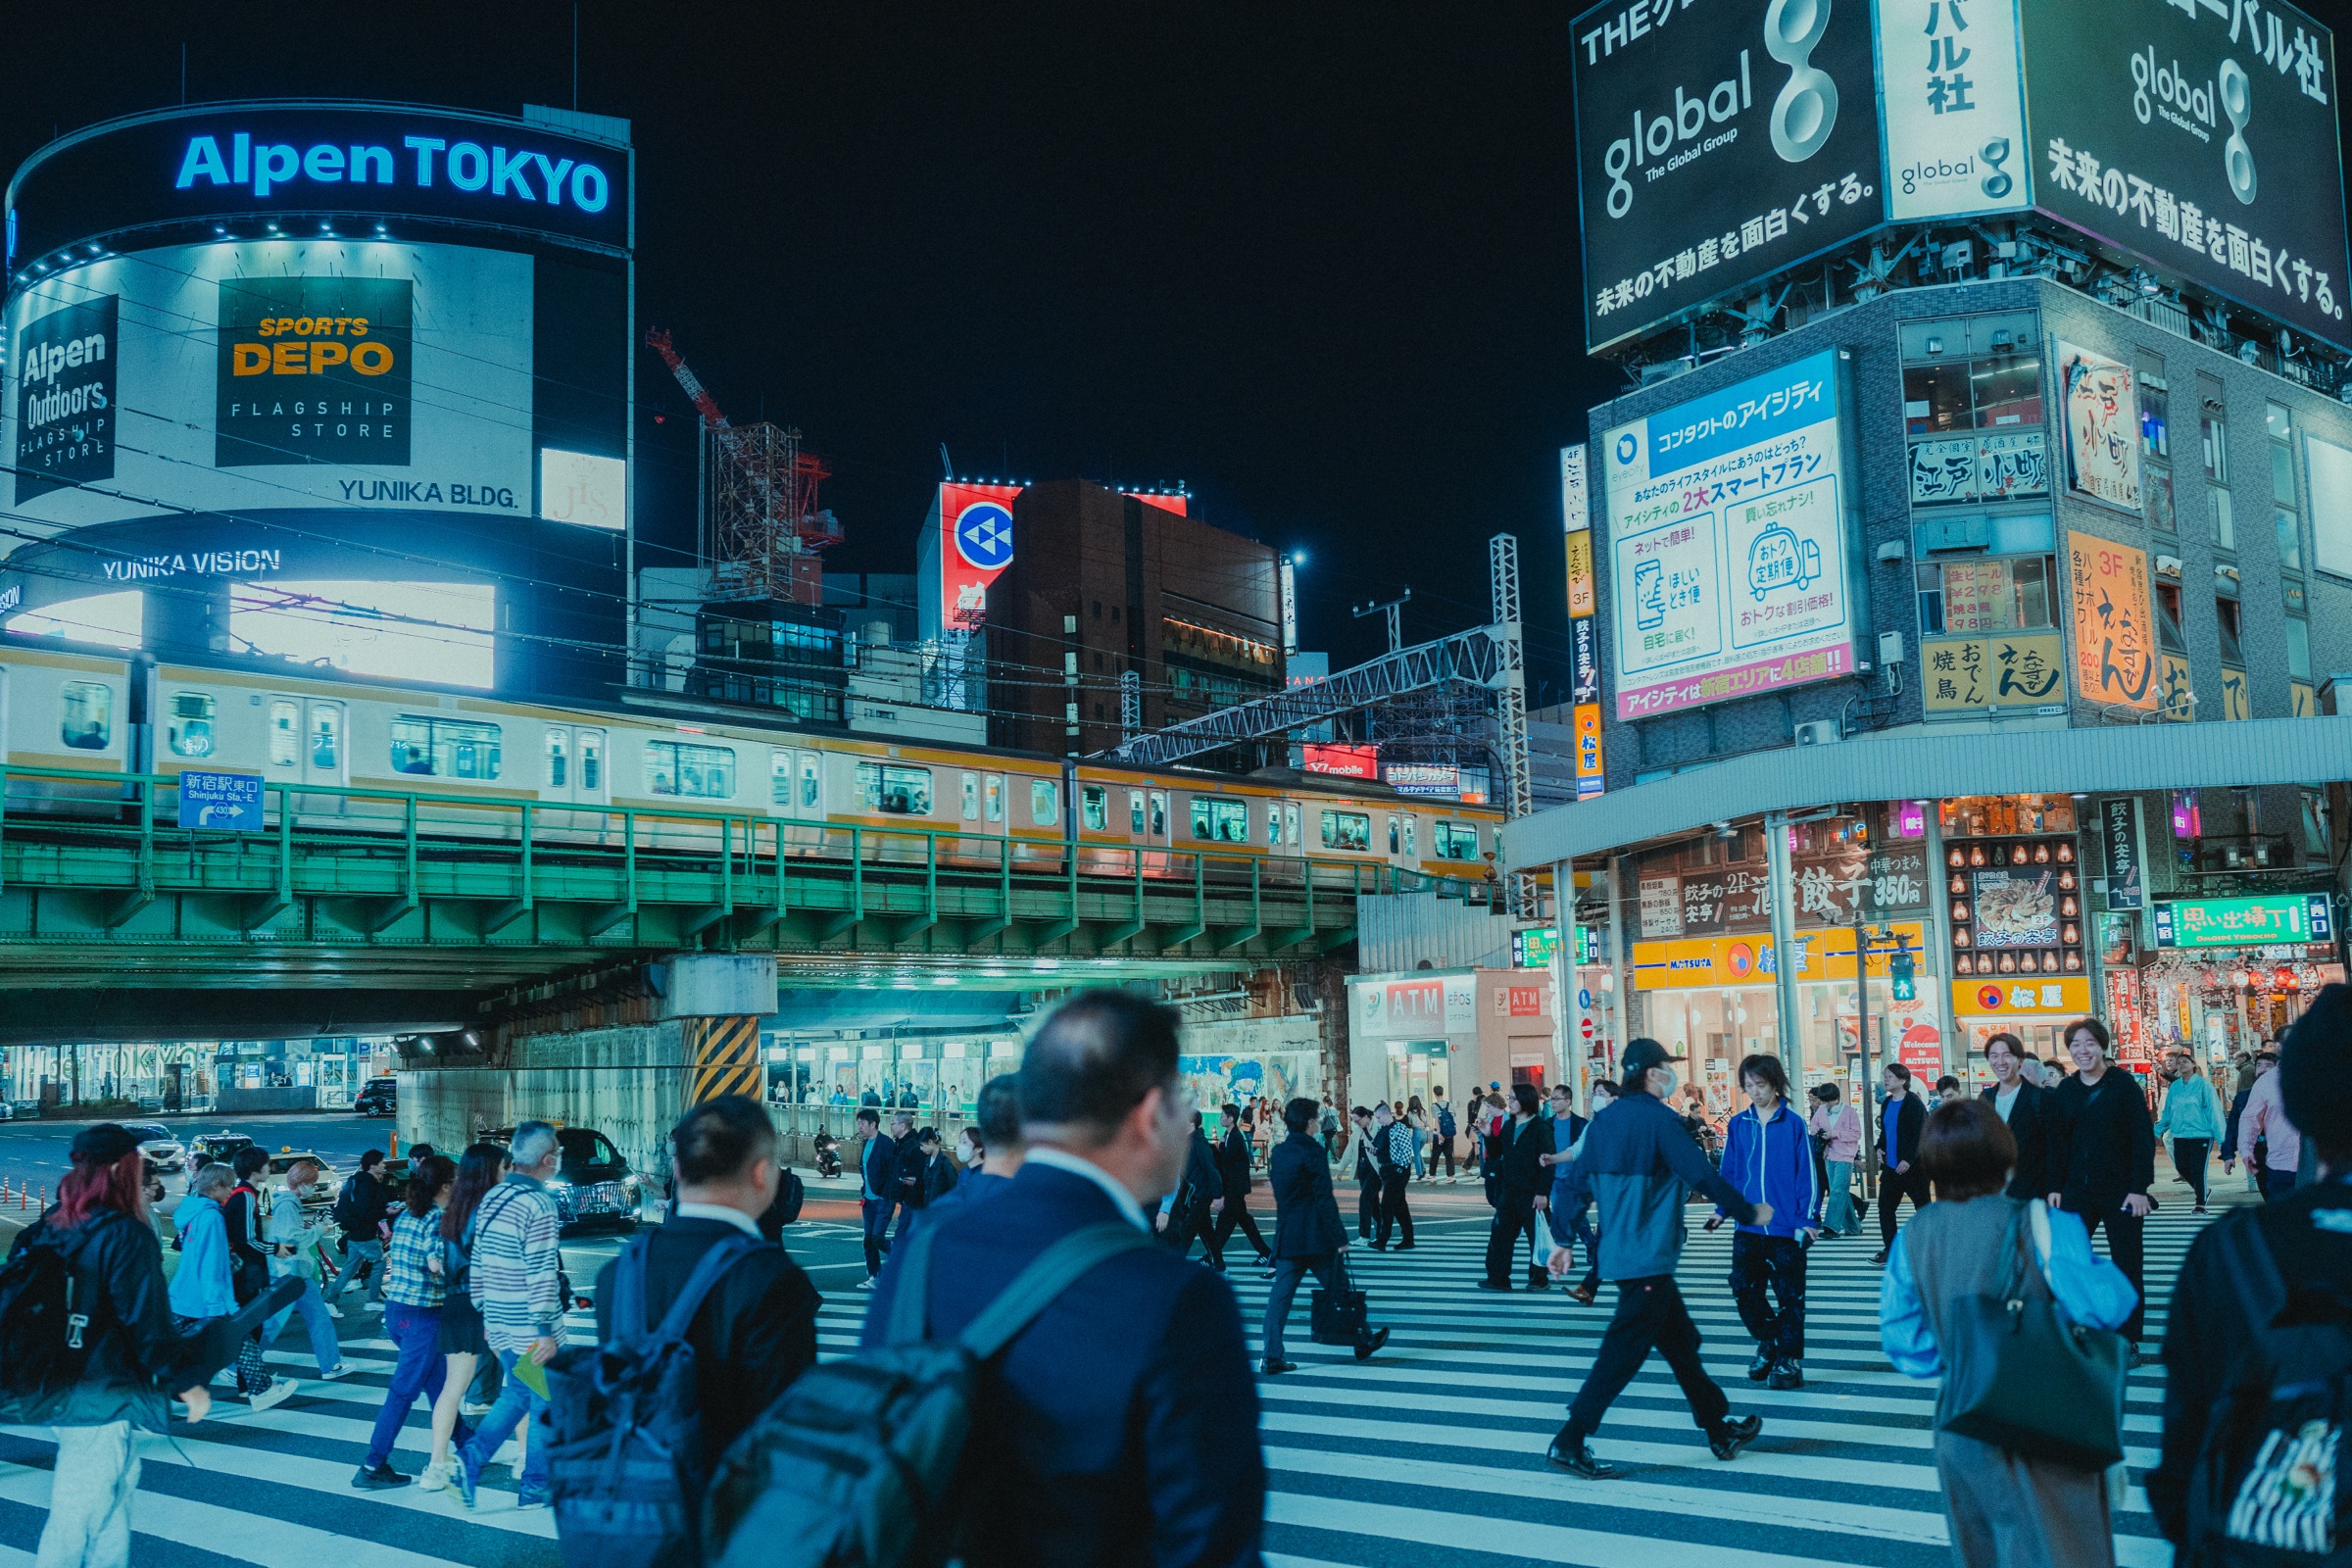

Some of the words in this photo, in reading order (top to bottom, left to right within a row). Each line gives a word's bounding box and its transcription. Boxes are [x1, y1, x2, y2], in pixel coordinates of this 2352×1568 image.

[2167, 0, 2327, 105] ーバル社
[2131, 45, 2217, 128] global
[1604, 49, 1752, 219] global
[2157, 105, 2170, 123] The
[2170, 110, 2190, 134] Global
[2190, 120, 2210, 144] Group
[1645, 164, 1665, 183] The
[1666, 142, 1702, 172] Global
[1703, 127, 1739, 154] Group
[176, 132, 394, 197] Alpen
[405, 134, 609, 213] TOKYO
[1901, 155, 1975, 195] global
[2048, 137, 2343, 321] 未来の不動産を面白くする。
[1595, 172, 1873, 318] 未来の不動産を面白くする。
[258, 318, 368, 337] SPORTS
[23, 333, 106, 388] Alpen
[232, 342, 394, 377] DEPO
[27, 381, 105, 430] Outdoors
[231, 402, 394, 417] FLAGSHIP
[1658, 380, 1824, 454] コンタクトのアイシティ
[21, 418, 105, 458] FLAGSHIP
[291, 422, 394, 438] STORE
[45, 440, 104, 466] STORE
[1612, 465, 1644, 482] eyecity
[338, 479, 444, 505] YUNIKA
[451, 483, 519, 509] BLDG.
[1635, 526, 1695, 556] ネットで簡単!
[1760, 539, 1787, 560] おトク
[103, 555, 186, 580] YUNIKA
[192, 549, 280, 574] VISION
[1669, 567, 1700, 588] ほしい
[1755, 556, 1793, 584] 定期便
[1950, 568, 2002, 583] 生ビール
[2099, 551, 2123, 577] 3F
[1573, 592, 1590, 605] 3F
[1669, 586, 1700, 611] とき便
[2073, 550, 2085, 644] 各種サワー
[2082, 553, 2098, 646] ハイボール
[1961, 643, 1984, 704] おでん
[2081, 651, 2099, 668] 200
[1933, 650, 1957, 700] 焼鳥
[1581, 734, 1597, 769] 松屋
[186, 774, 258, 793] 新宿駅東口
[1388, 771, 1456, 781] ヨドバシカメラ
[188, 791, 224, 802] Shinjuku
[2110, 802, 2131, 874] 餃子の安亭
[1870, 856, 1921, 874] 中華つまみ
[1685, 883, 1723, 902] 餃子の
[1727, 872, 1749, 894] 2F
[1750, 862, 1872, 915] 酒餃子
[1686, 904, 1713, 923] 安亭
[2157, 911, 2174, 939] 新宿
[2182, 906, 2287, 932] 思い出横丁
[2310, 904, 2328, 933] 西口
[1977, 928, 2057, 947] 餃子の安亭
[1393, 988, 1439, 1016] ATM
[1447, 993, 1471, 1006] EPOS
[1512, 992, 1538, 1005] ATM
[2009, 985, 2064, 1008] 松屋
